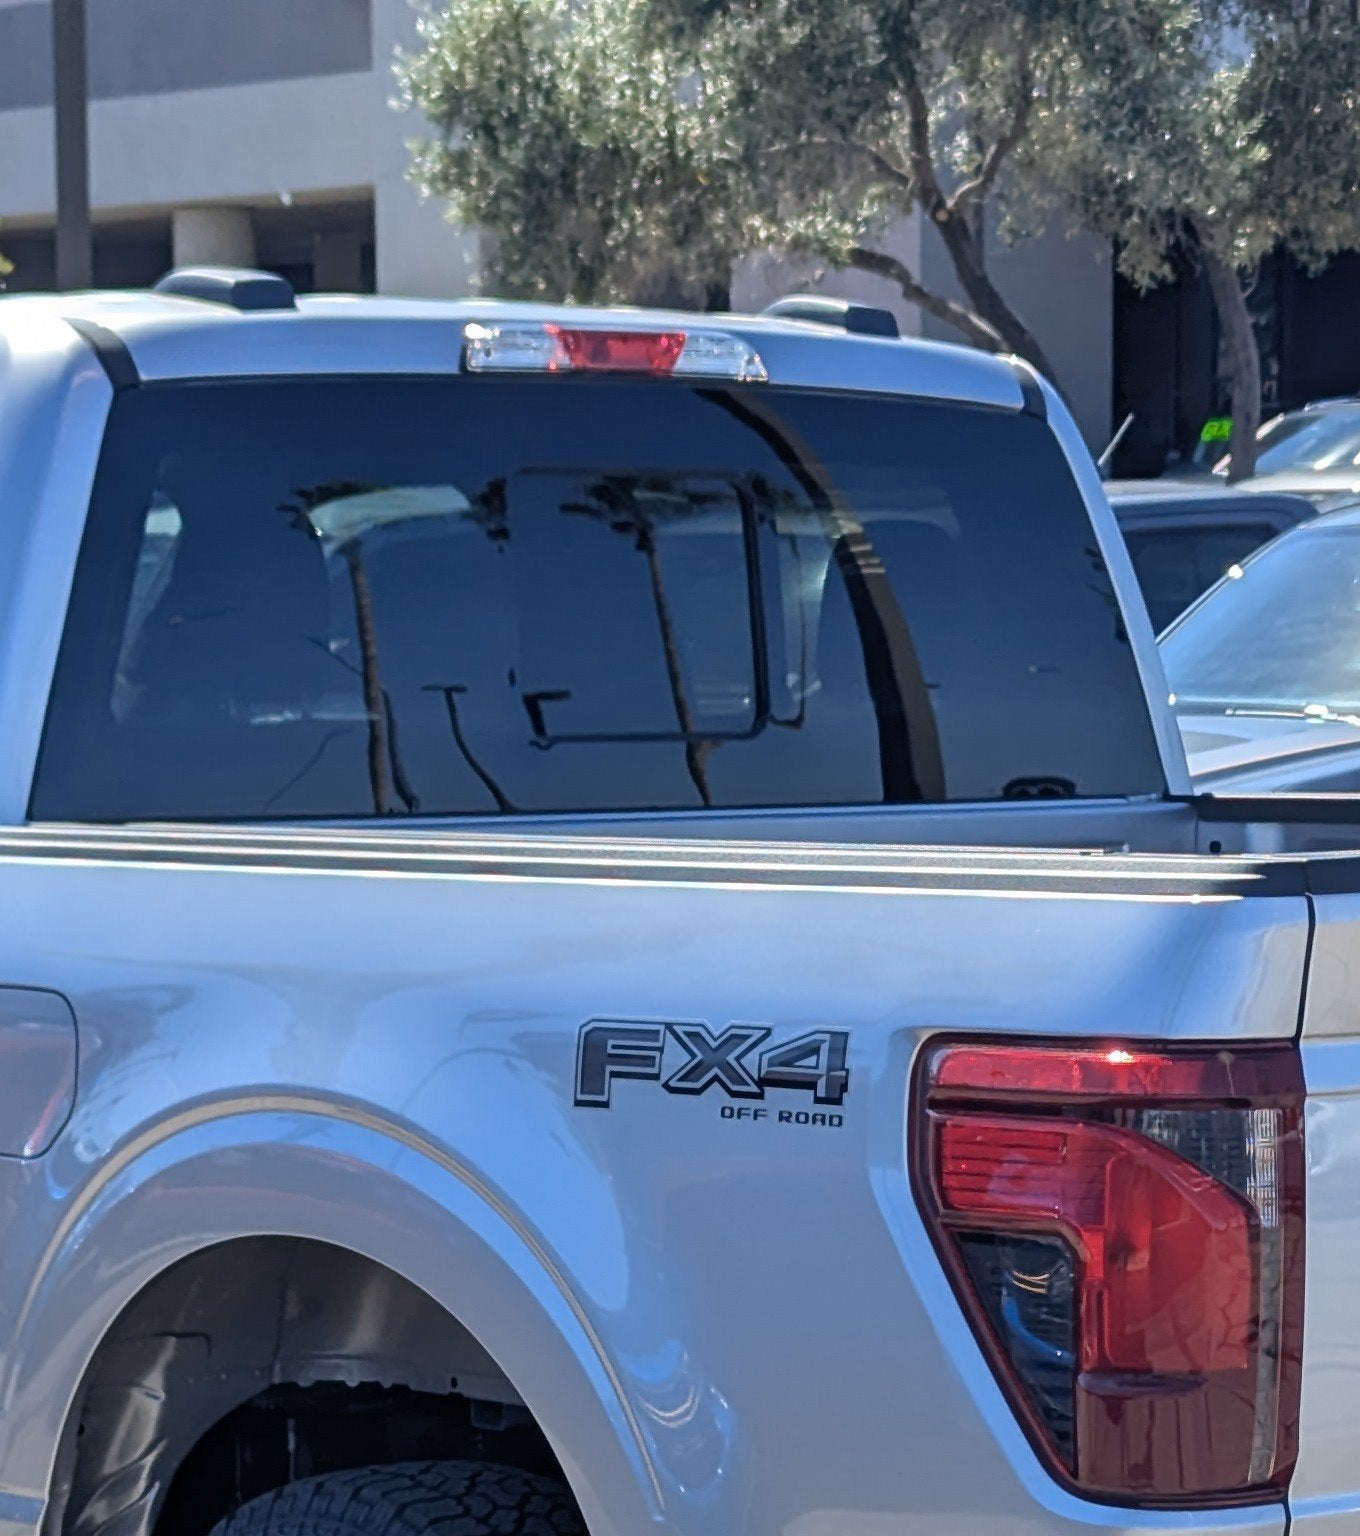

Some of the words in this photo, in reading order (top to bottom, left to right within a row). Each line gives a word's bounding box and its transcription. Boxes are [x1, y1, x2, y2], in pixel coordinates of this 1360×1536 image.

[574, 1018, 851, 1108] FX4
[720, 1105, 768, 1121] OFF
[778, 1109, 843, 1127] ROAD
